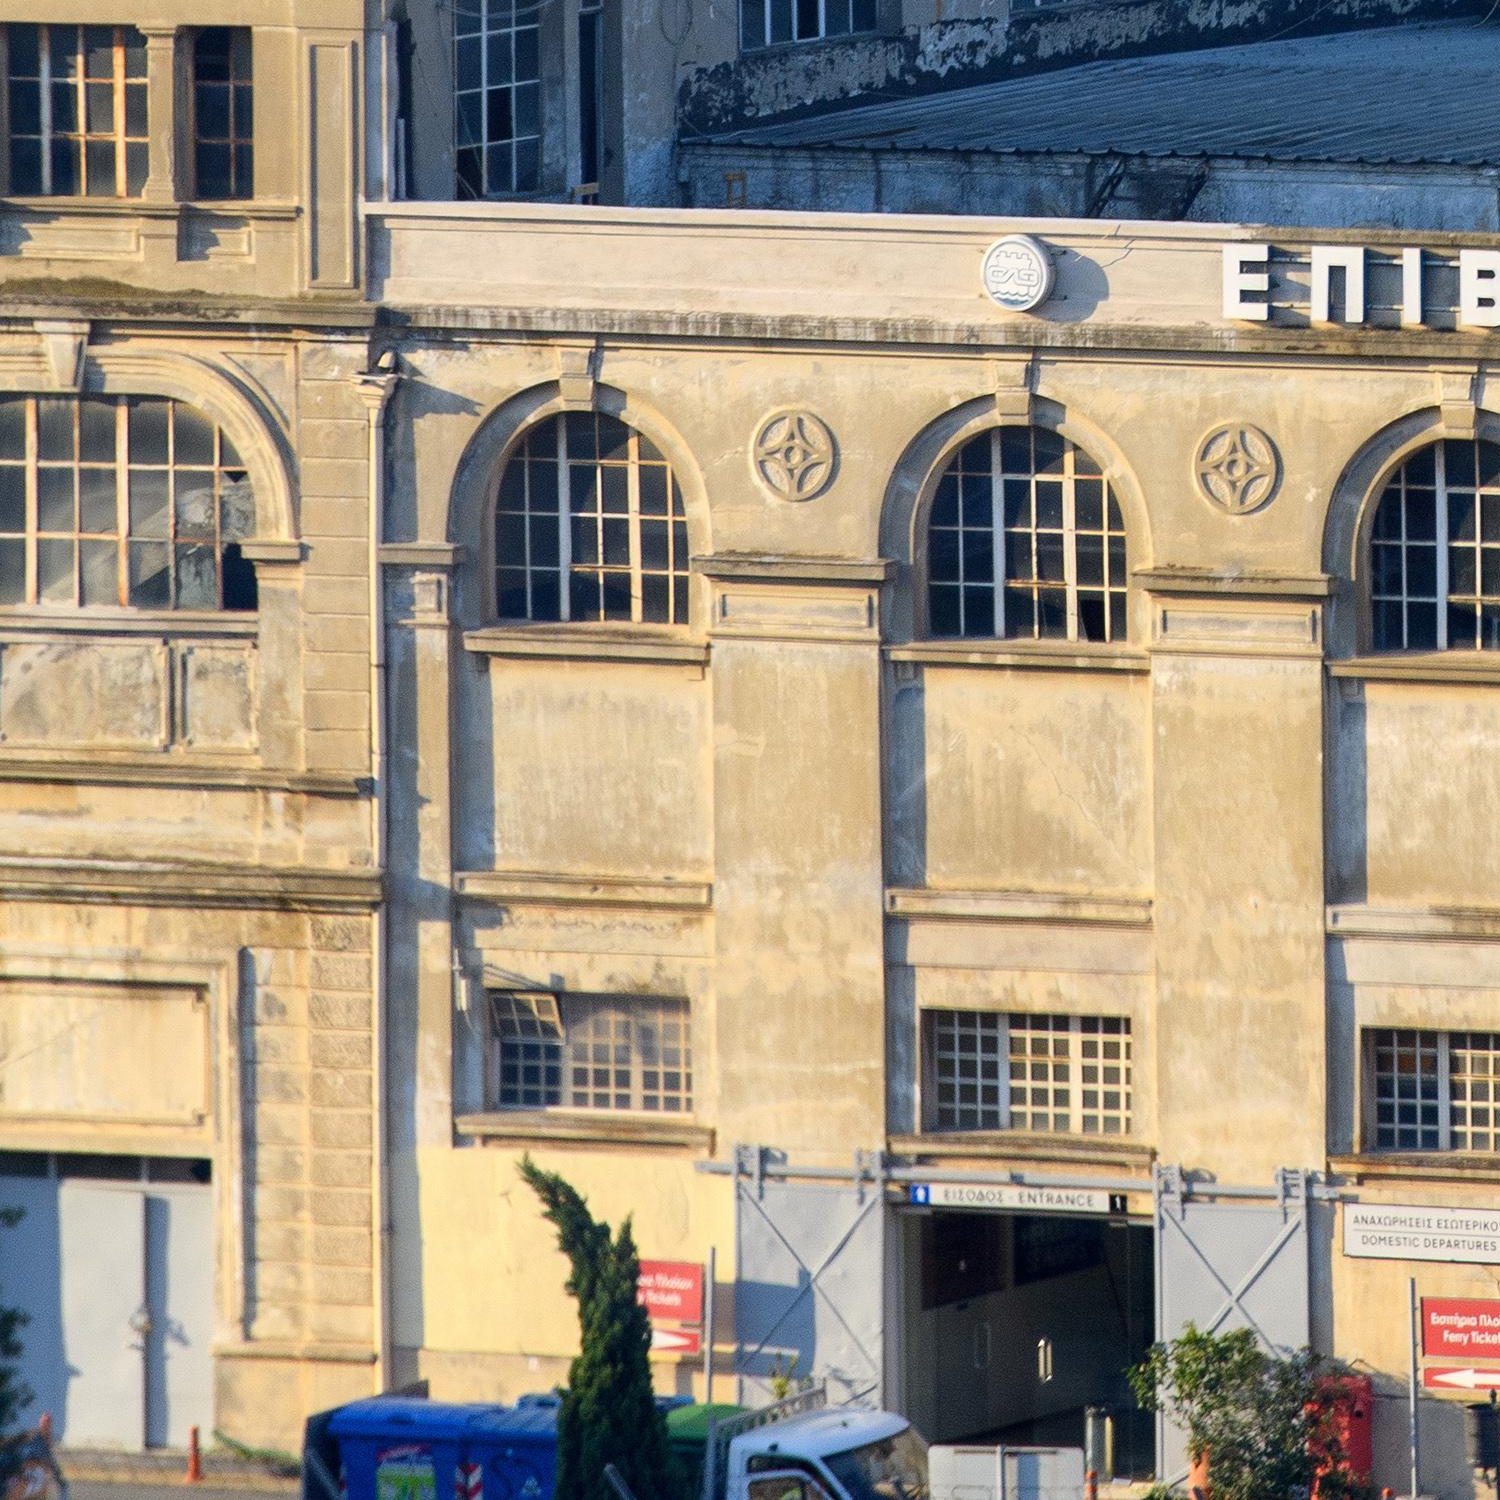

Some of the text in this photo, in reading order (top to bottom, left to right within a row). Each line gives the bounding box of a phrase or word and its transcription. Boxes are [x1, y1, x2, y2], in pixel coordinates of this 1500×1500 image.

[944, 1189, 1005, 1203] ΕΙΣΟΔΟΣ
[1017, 1193, 1094, 1207] ENTRANCE
[1352, 1214, 1433, 1230] ΑΝΑΧΩΡΗΣΕΙΣ
[1361, 1235, 1497, 1252] DOMESTIC DEPARTURES
[1443, 1330, 1470, 1346] Ferry
